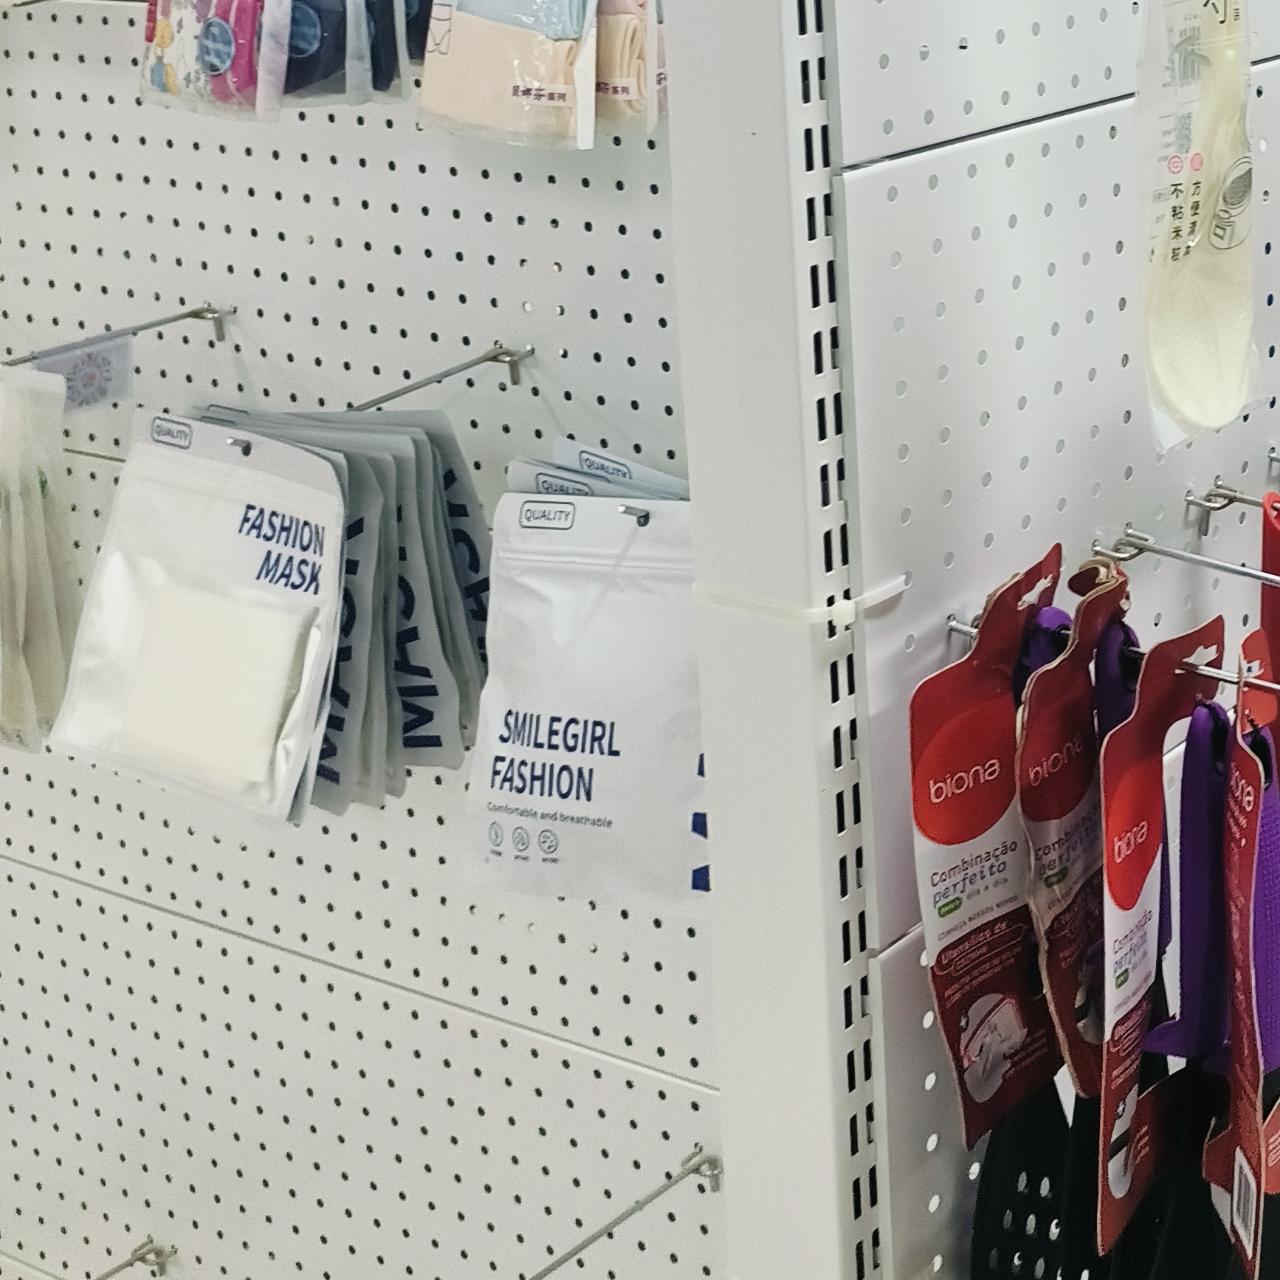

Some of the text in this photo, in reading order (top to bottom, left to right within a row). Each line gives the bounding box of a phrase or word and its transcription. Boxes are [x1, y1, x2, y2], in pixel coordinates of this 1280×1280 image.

[238, 503, 325, 557] FASHION
[524, 508, 570, 522] QUALITY
[256, 550, 322, 595] MASK
[499, 709, 621, 756] SMILEGIRL
[490, 755, 594, 802] FASHION
[929, 758, 1000, 803] biona
[487, 801, 613, 829] Comfortable and breathable
